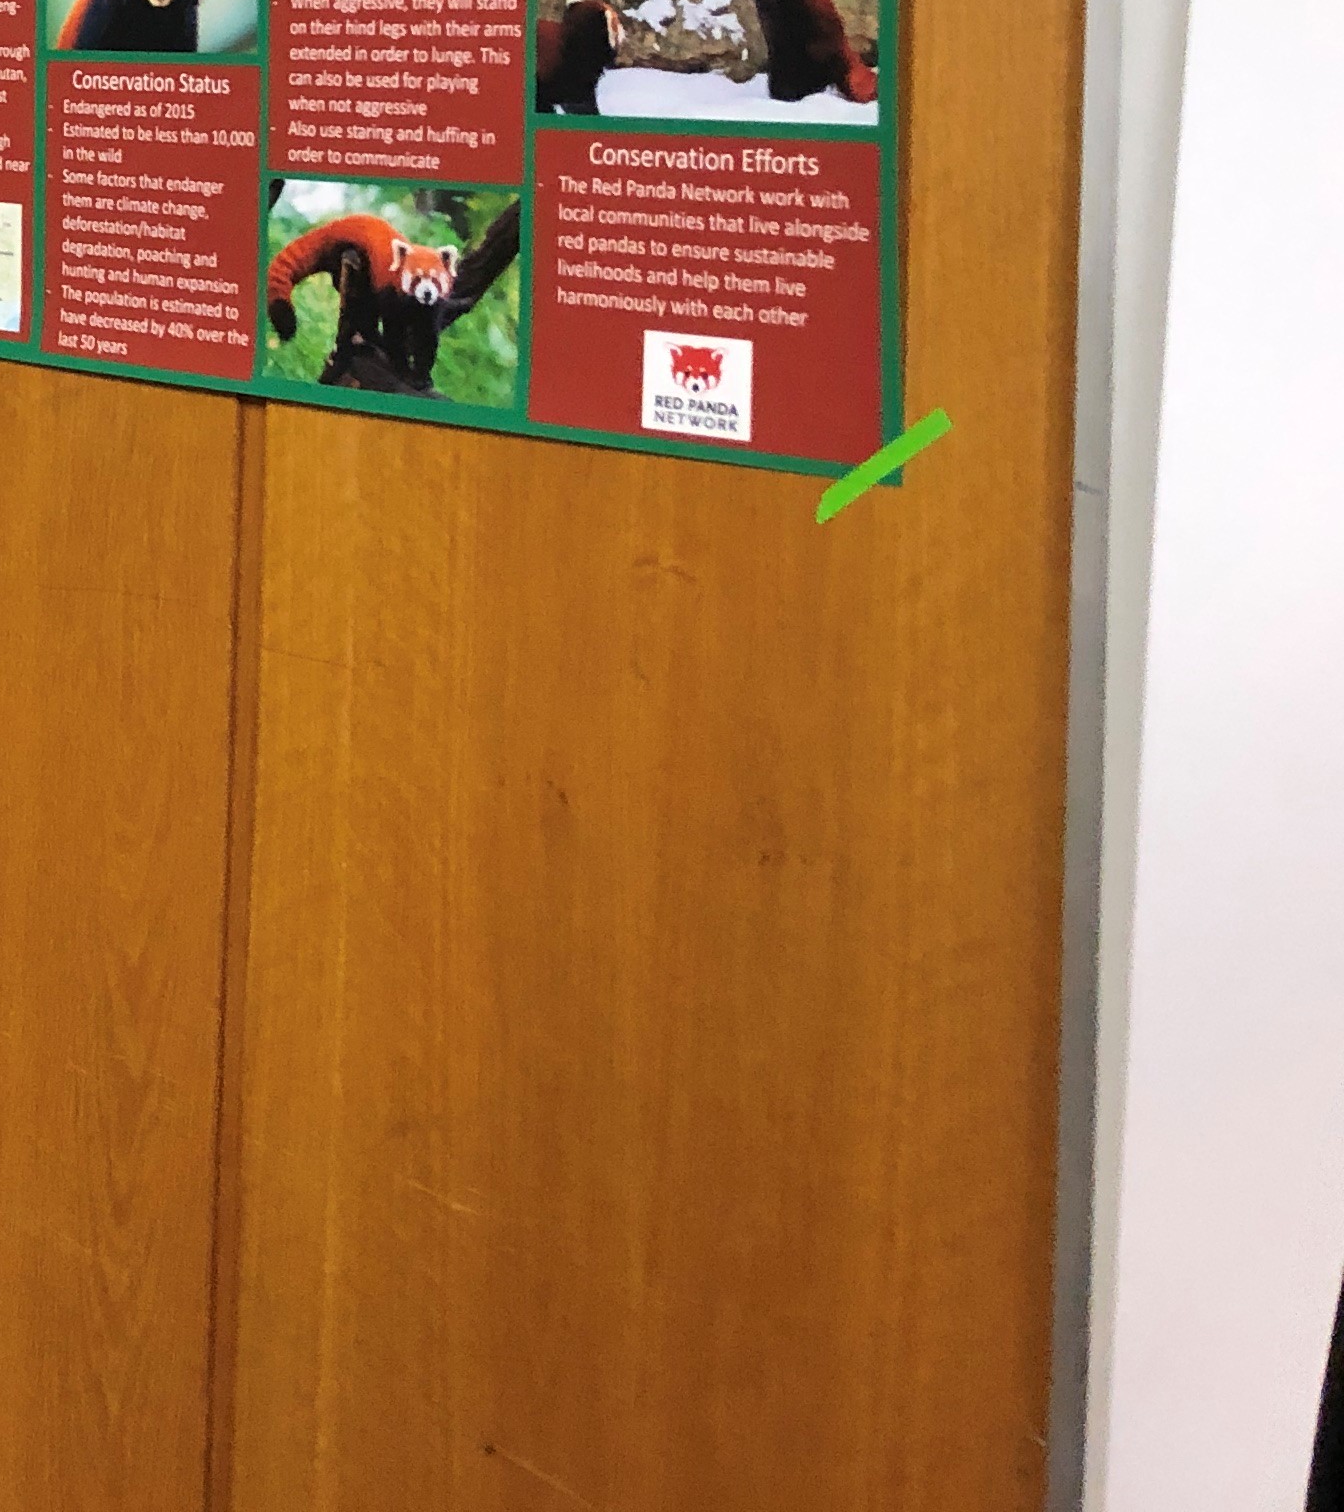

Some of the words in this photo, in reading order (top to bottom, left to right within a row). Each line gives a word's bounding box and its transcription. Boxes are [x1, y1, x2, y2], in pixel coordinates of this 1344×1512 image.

[72, 69, 175, 92] Conservation
[178, 72, 230, 94] Status
[63, 98, 131, 117] Endangered
[133, 105, 147, 117] as
[149, 102, 162, 118] of
[164, 102, 195, 119] 2015
[63, 121, 120, 140] Estimated
[121, 126, 135, 140] to
[137, 125, 153, 142] be
[154, 126, 178, 143] less
[180, 127, 209, 144] than
[212, 129, 255, 147] 10,000
[62, 145, 74, 160] in
[75, 146, 95, 162] the
[97, 147, 122, 163] wild
[589, 141, 734, 171] Conservation
[741, 148, 819, 176] Efforts
[561, 175, 588, 194] The
[591, 177, 622, 196] Red
[626, 179, 677, 199] Panda
[681, 182, 755, 204] Network
[759, 188, 805, 207] work
[809, 191, 850, 209] with
[558, 203, 594, 222] local
[597, 209, 705, 231] communities
[708, 213, 744, 233] that
[748, 215, 780, 236] live
[784, 218, 870, 243] alongside
[654, 394, 684, 411] RED
[688, 399, 739, 418] PANDA
[653, 409, 739, 433] NETWORK
